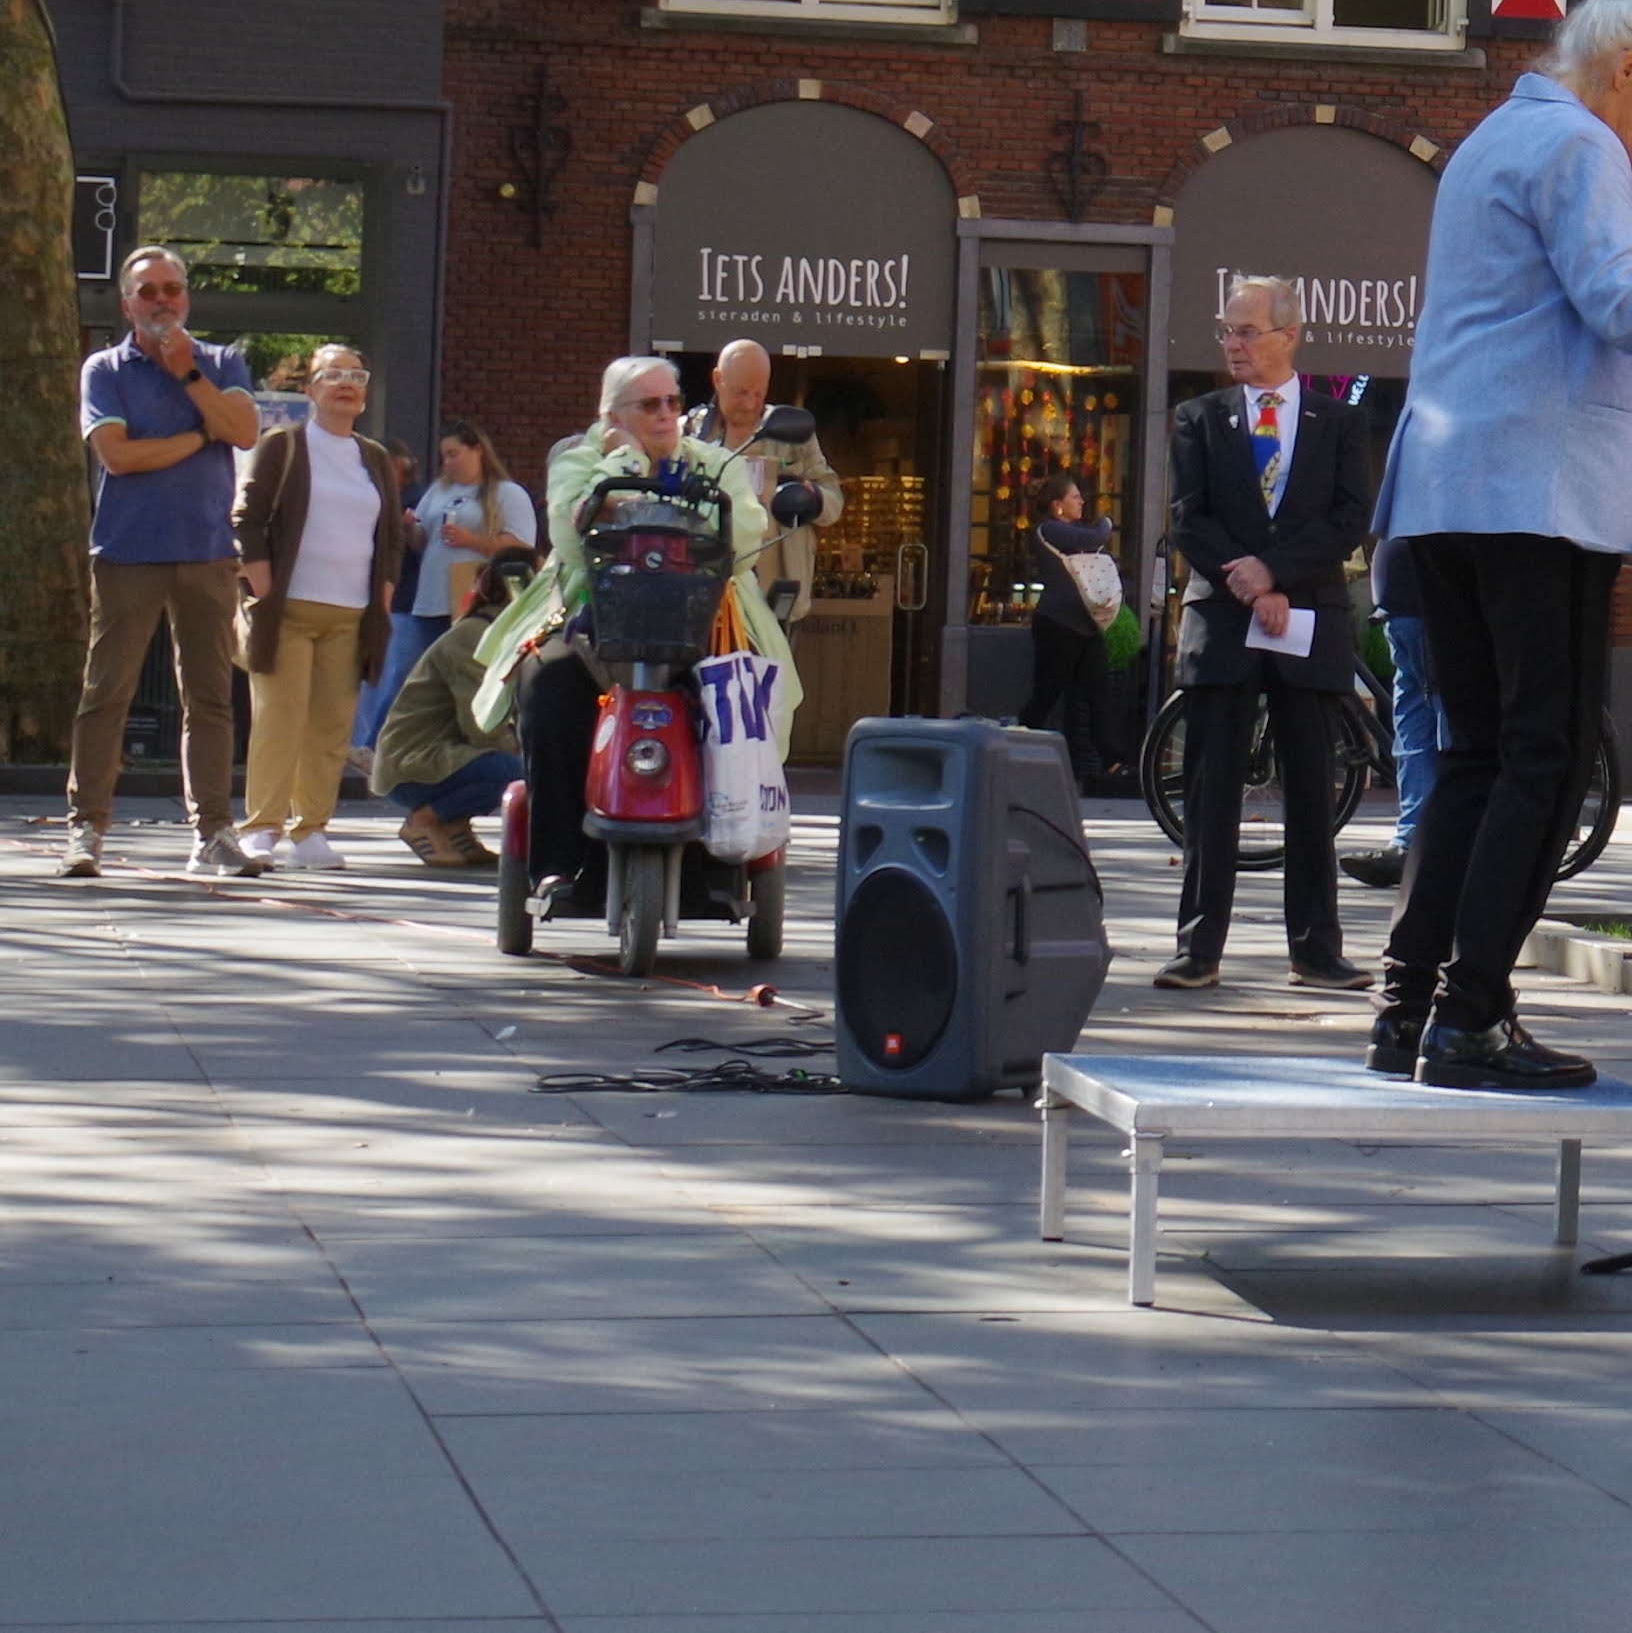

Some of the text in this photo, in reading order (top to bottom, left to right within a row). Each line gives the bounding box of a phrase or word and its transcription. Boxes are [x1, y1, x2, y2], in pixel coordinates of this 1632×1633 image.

[698, 310, 908, 330] sieraden & lifestyle
[1304, 330, 1315, 344] &
